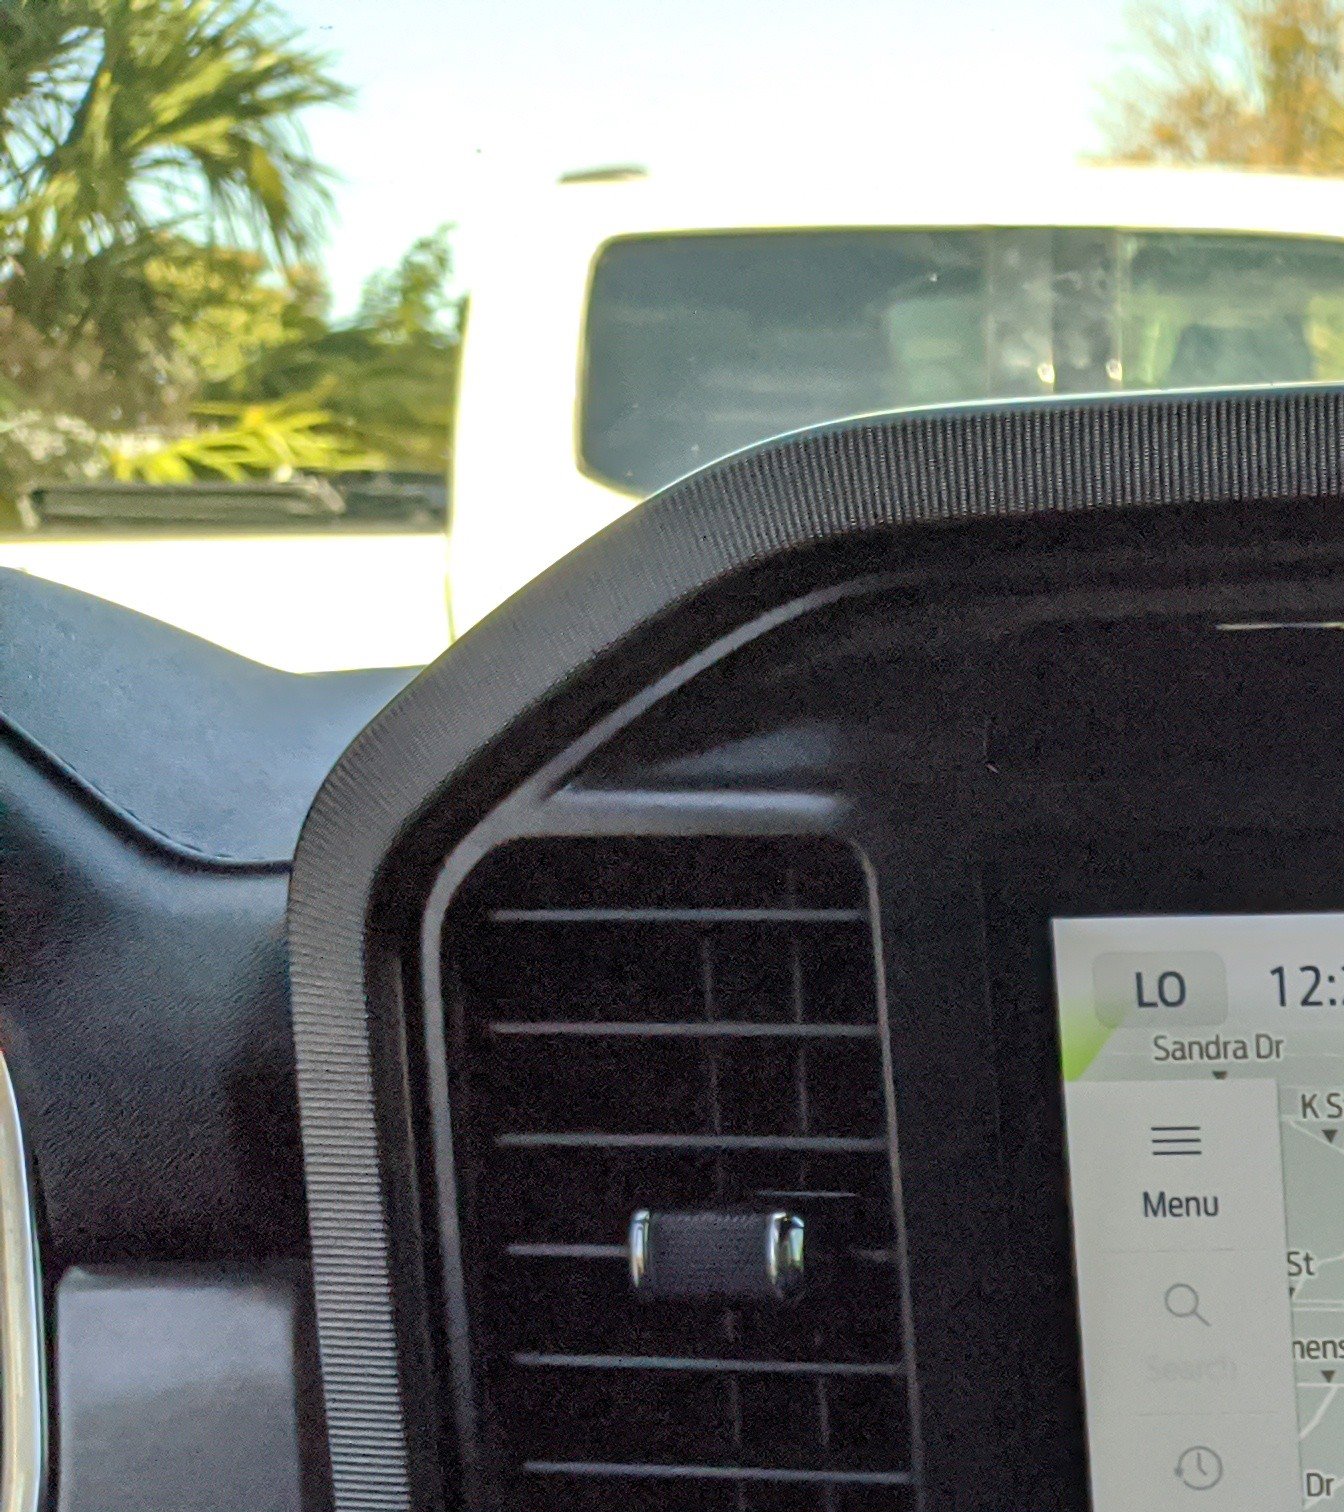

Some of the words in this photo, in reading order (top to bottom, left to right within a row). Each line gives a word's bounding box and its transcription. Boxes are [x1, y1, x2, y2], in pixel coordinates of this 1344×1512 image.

[1135, 970, 1187, 1009] LO
[1153, 1034, 1248, 1061] Sandra
[1254, 1033, 1284, 1060] Dr
[1301, 1095, 1319, 1119] K
[1142, 1191, 1220, 1219] Menu
[1286, 1251, 1315, 1277] St
[1306, 1472, 1334, 1497] Dr
